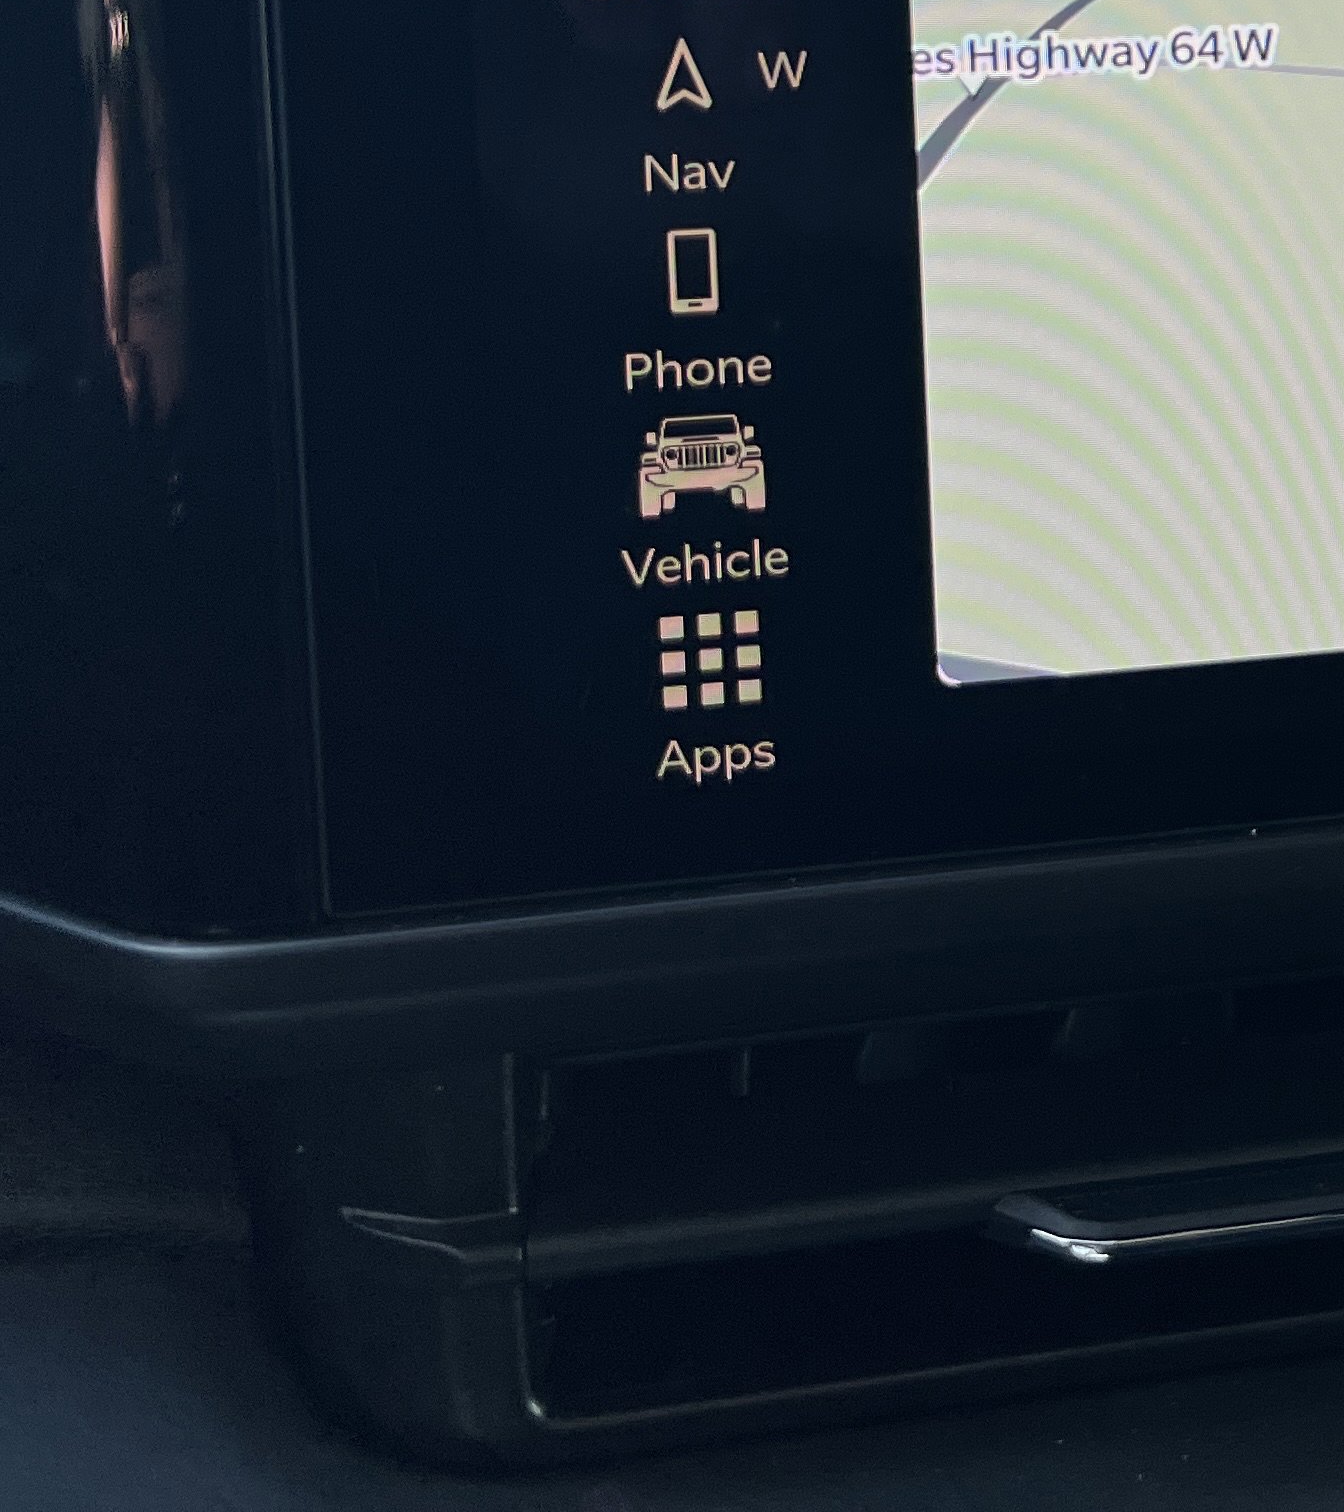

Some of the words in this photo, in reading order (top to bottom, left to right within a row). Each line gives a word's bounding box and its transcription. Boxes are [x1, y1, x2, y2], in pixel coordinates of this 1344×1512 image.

[757, 50, 808, 90] W
[968, 36, 1160, 81] Highway
[1170, 30, 1225, 66] 64
[1232, 28, 1274, 62] W
[643, 153, 736, 193] Nav
[624, 350, 772, 391] Phone
[620, 539, 790, 586] Vehicle
[656, 739, 776, 787] Apps
